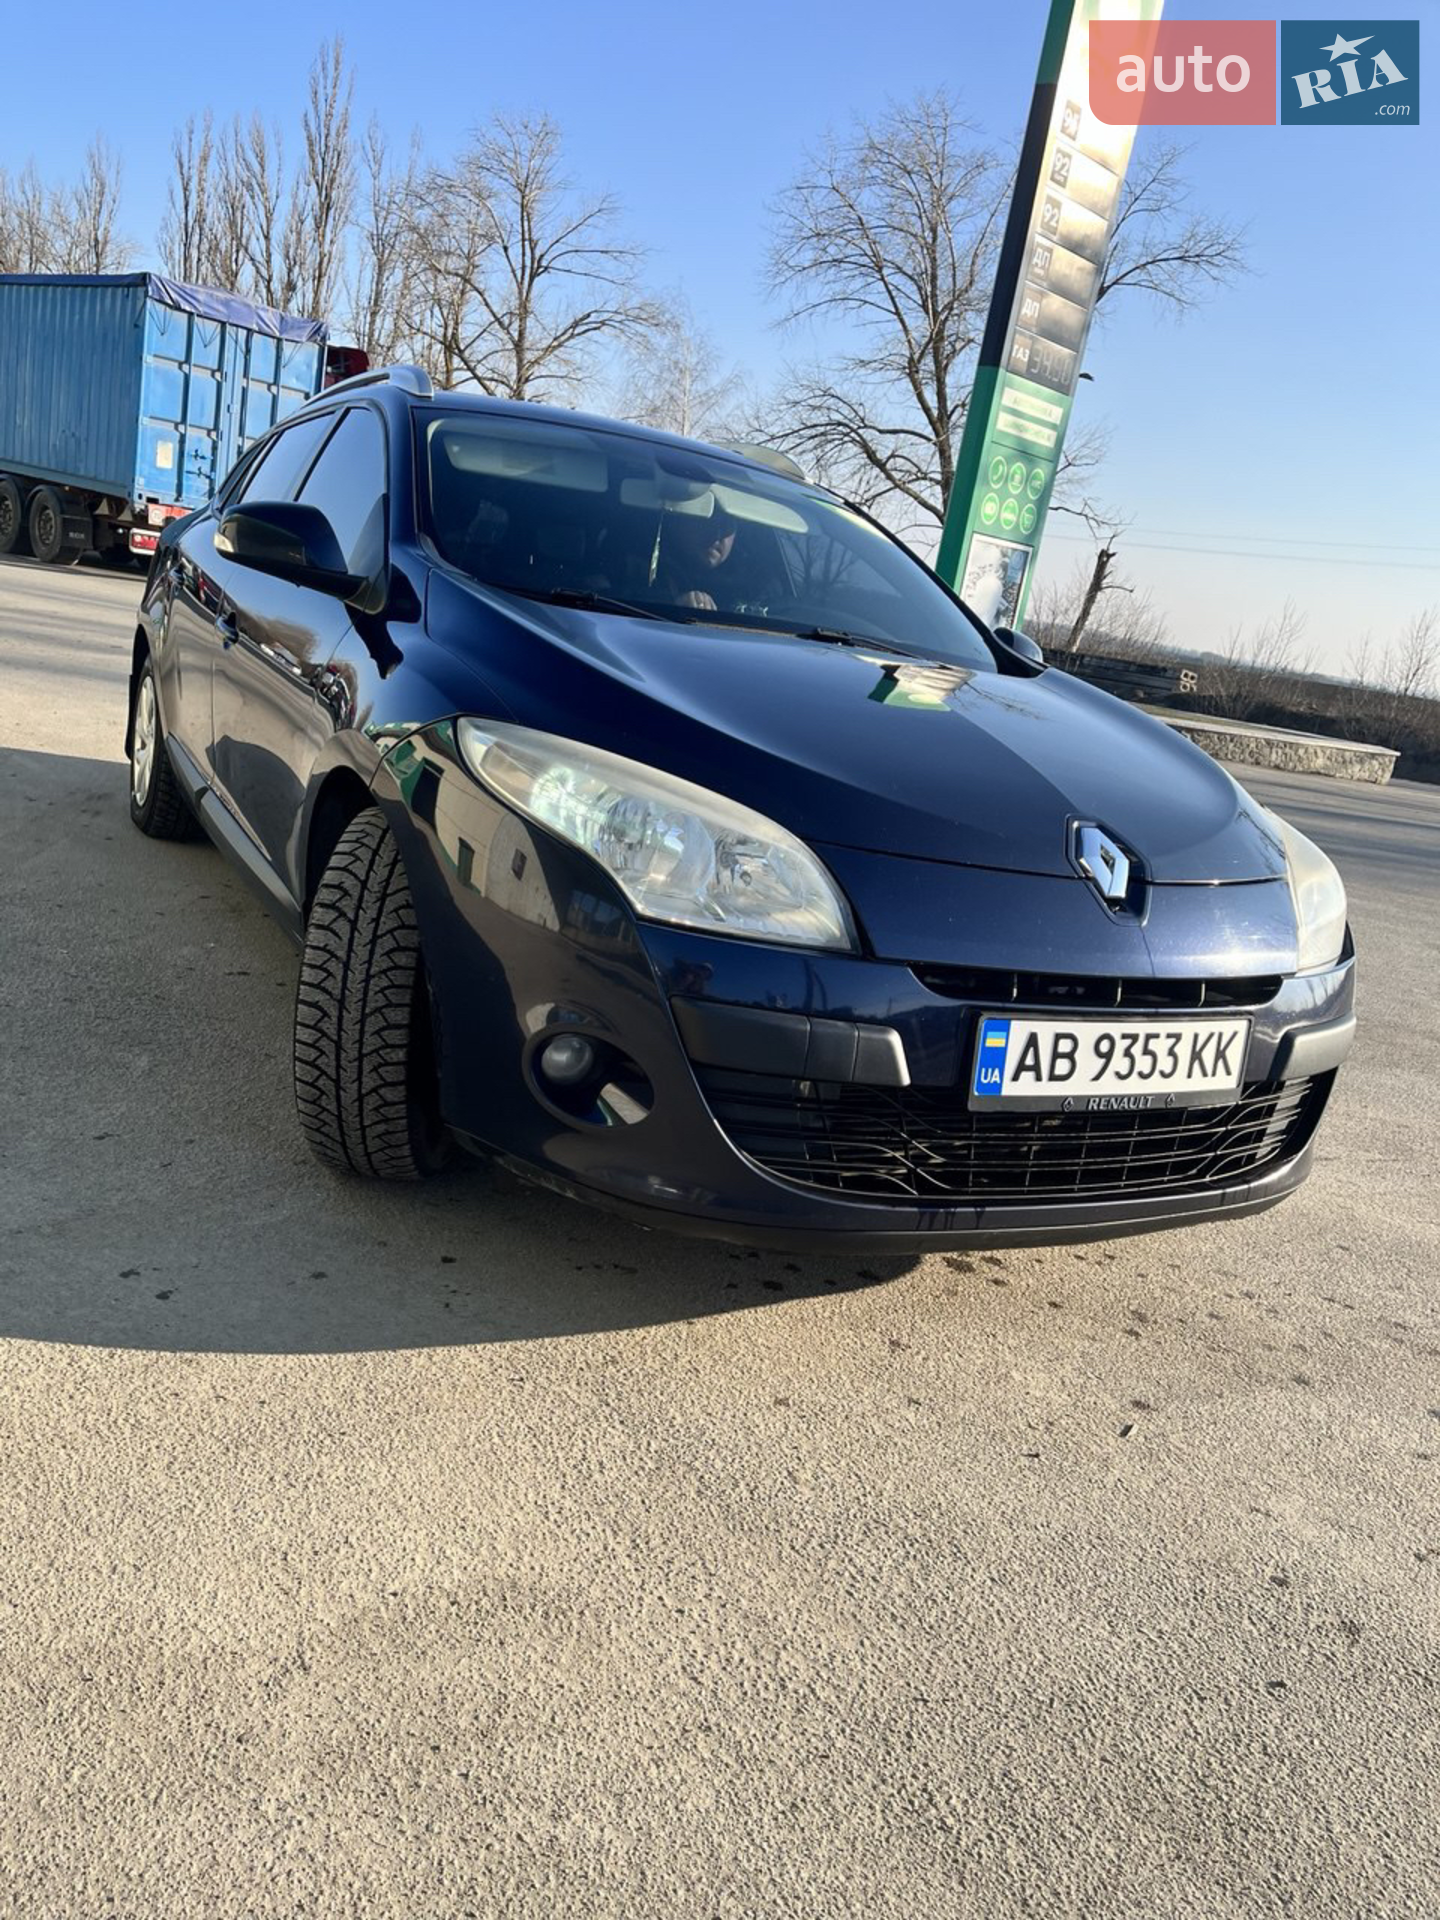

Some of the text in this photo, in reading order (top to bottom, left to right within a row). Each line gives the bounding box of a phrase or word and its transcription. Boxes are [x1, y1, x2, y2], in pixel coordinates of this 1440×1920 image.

[1011, 1030, 1239, 1082] AB 9353 KK
[980, 1068, 1001, 1084] UA
[1088, 1096, 1155, 1111] RENAULT
